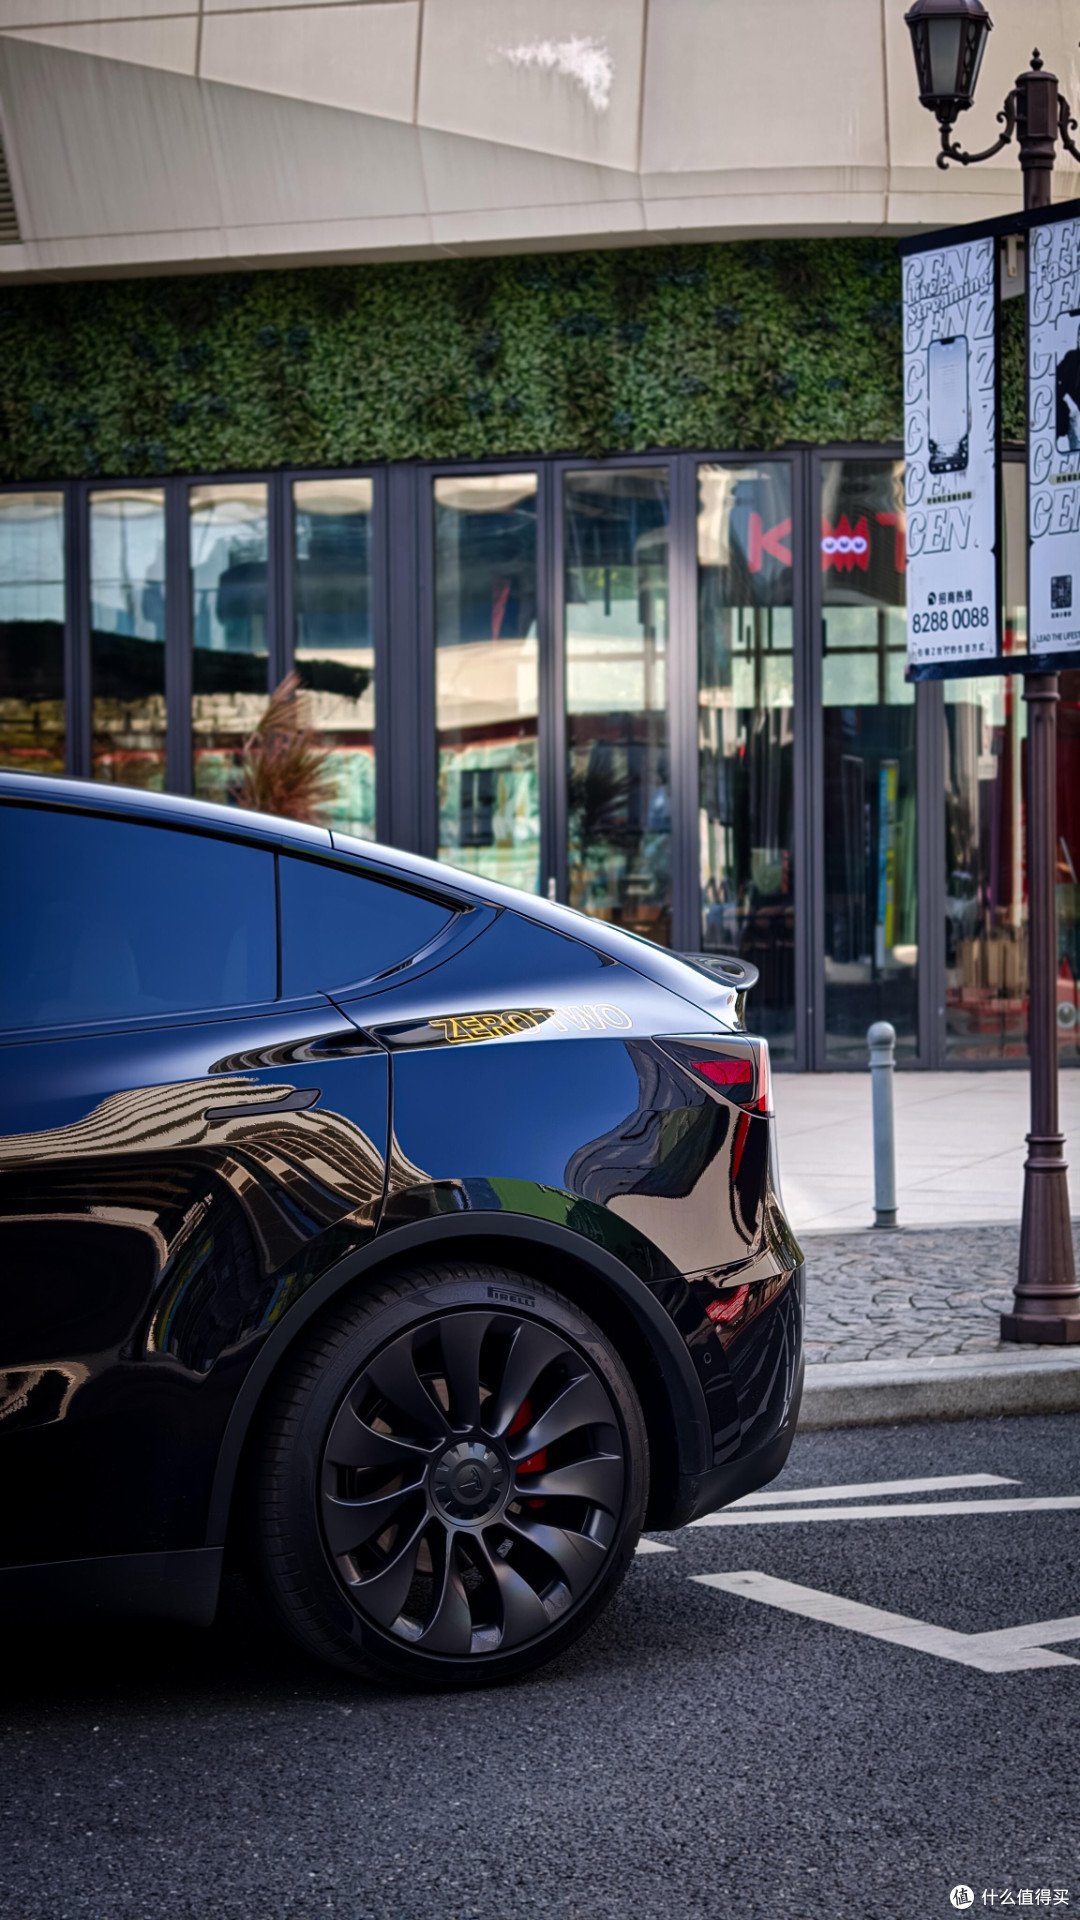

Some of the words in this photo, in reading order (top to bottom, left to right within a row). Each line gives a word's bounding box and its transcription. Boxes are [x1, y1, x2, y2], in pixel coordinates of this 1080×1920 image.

[907, 506, 971, 557] GEN
[938, 589, 973, 605] 招商热线
[912, 610, 948, 634] 8288
[952, 606, 989, 630] 0088
[429, 1011, 540, 1044] ZERO
[530, 1003, 633, 1032] TWO
[487, 1286, 536, 1308] PIRELLI
